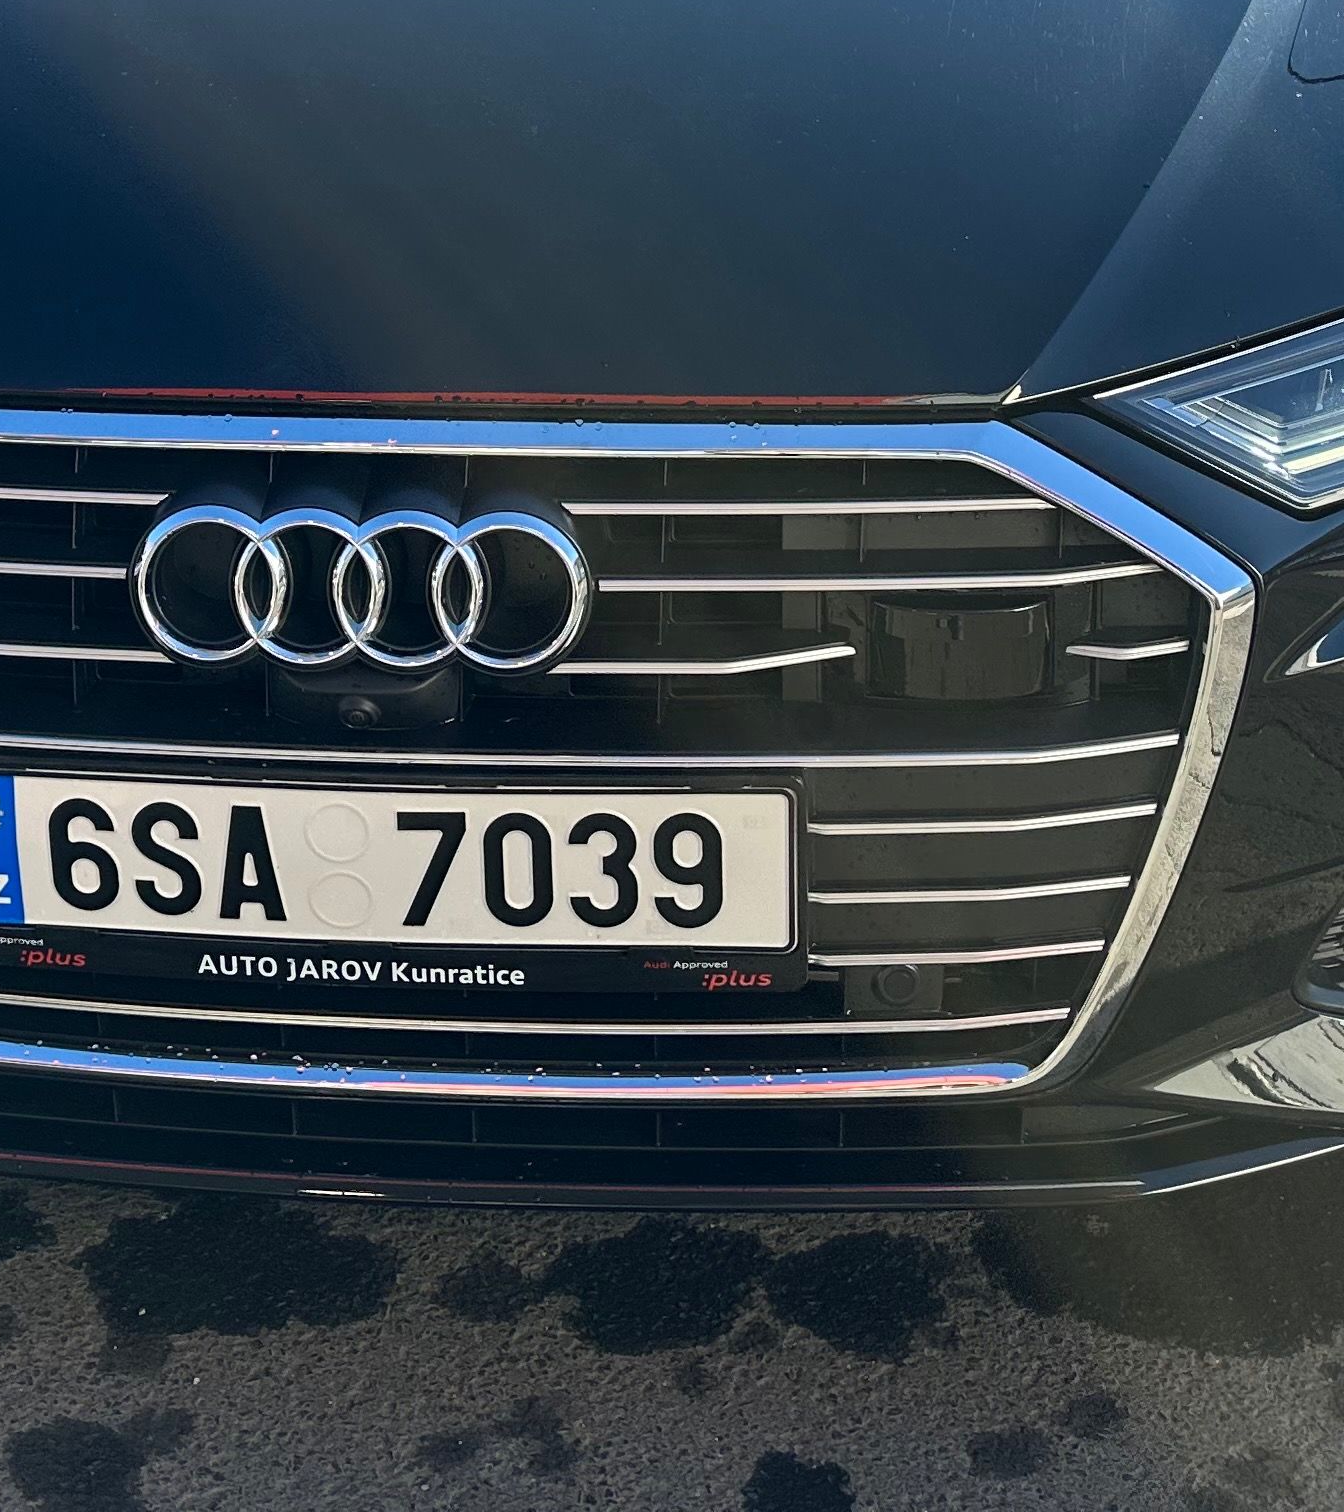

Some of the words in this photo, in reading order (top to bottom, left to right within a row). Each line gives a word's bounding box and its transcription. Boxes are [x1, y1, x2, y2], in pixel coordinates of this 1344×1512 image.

[49, 798, 287, 922] 6SA
[396, 811, 723, 928] 7039
[198, 954, 278, 977] AUTO
[286, 958, 382, 982] JAROV
[391, 962, 525, 985] Kunratice
[673, 960, 728, 971] Approved
